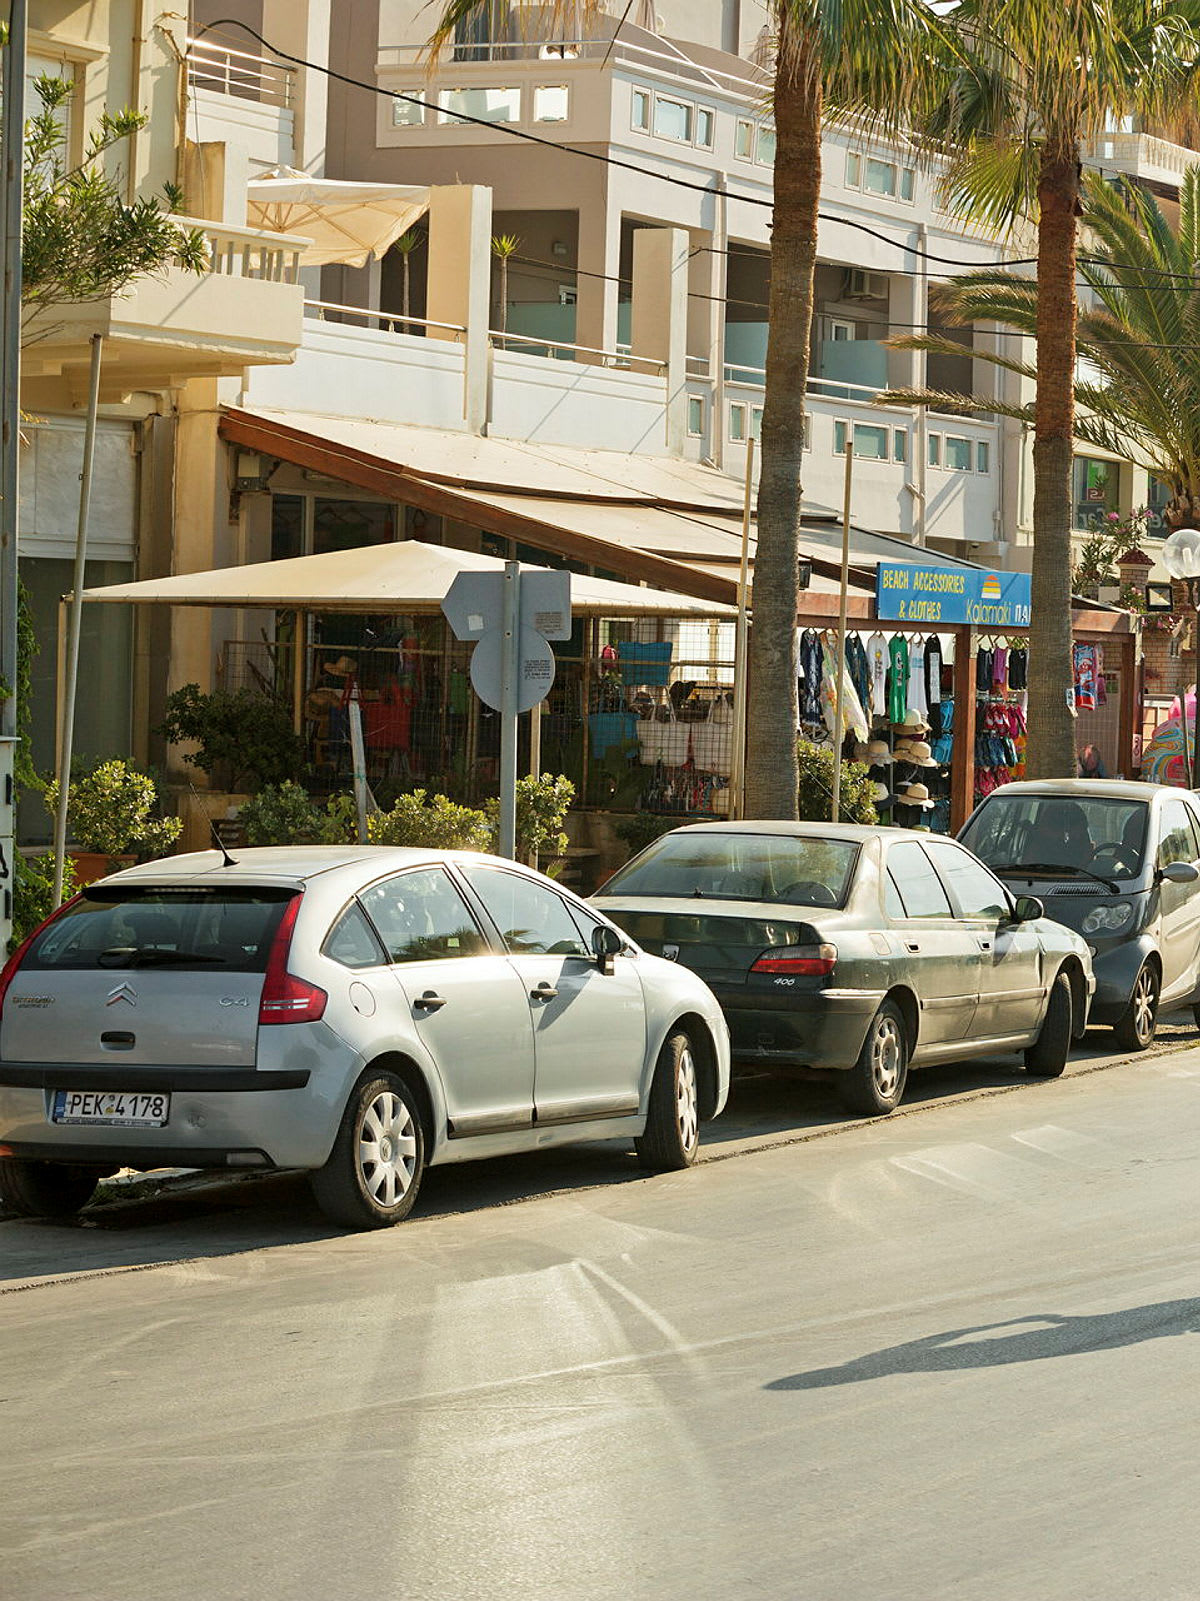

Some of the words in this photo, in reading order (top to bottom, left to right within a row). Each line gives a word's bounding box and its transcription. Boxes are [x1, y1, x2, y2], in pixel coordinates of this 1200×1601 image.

[882, 569, 909, 589] BEACH
[912, 572, 965, 594] ACCESSORIES
[898, 601, 906, 617] &
[907, 601, 942, 620] CLOTHES
[965, 598, 1012, 624] Kalamaki
[773, 978, 795, 986] 406
[219, 997, 251, 1007] C4
[69, 1094, 103, 1116] PEK
[114, 1096, 165, 1118] 4178
